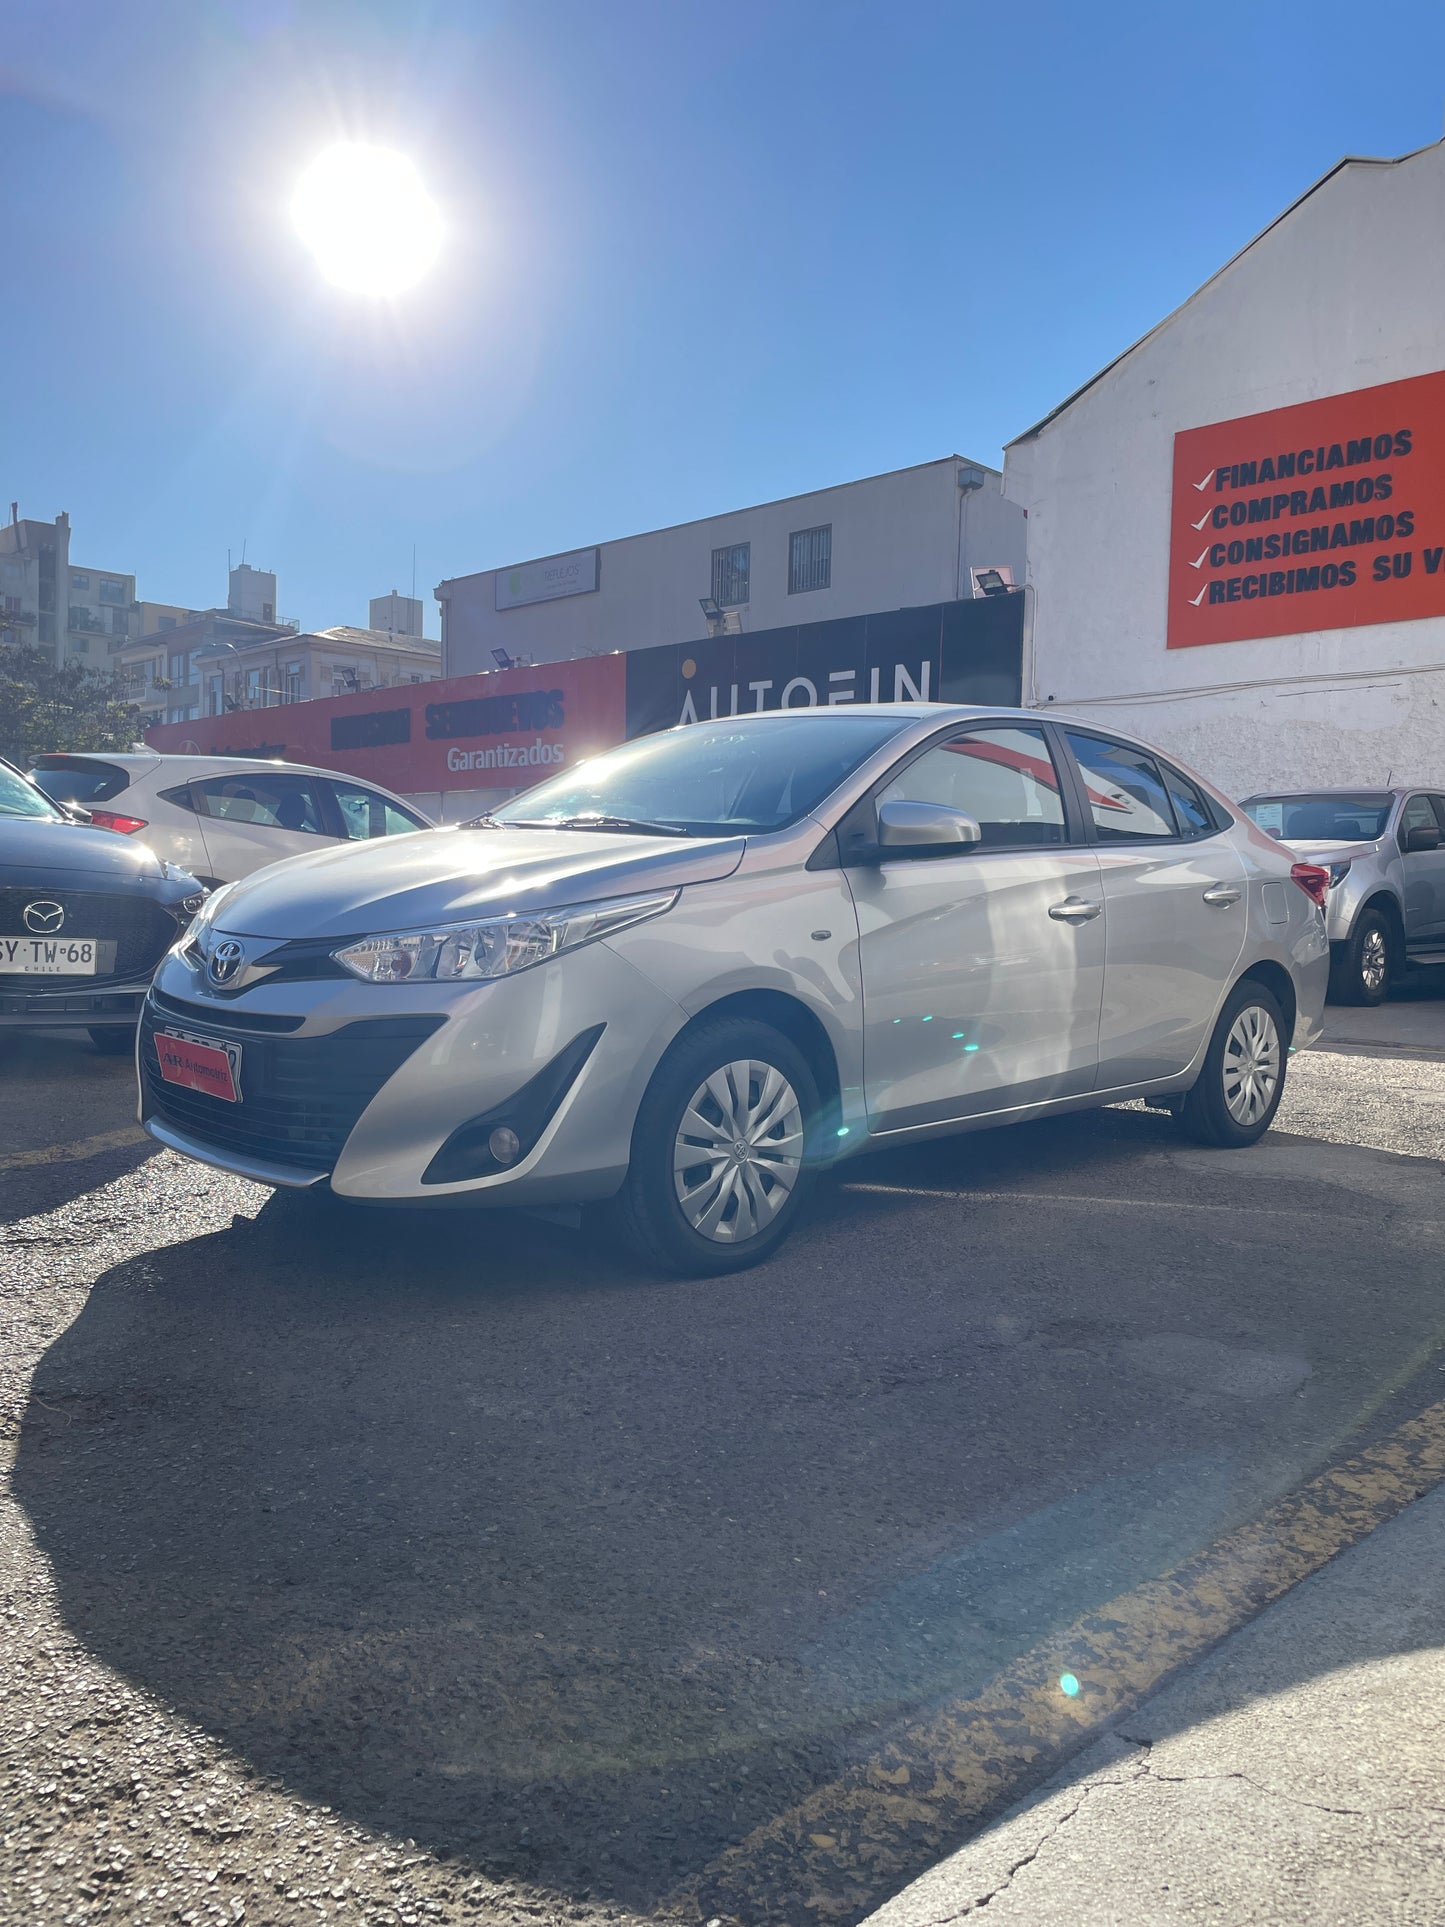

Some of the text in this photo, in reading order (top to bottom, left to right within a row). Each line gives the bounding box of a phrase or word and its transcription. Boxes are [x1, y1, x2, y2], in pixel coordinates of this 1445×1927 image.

[1215, 429, 1413, 492] FINANCIAMOS
[1212, 473, 1393, 530] COMPRAMOS
[1209, 511, 1415, 568] CONSIGNAMOS
[1208, 547, 1445, 605] RECIBIMOS SU V
[679, 661, 931, 726] AUTOFIN
[447, 738, 565, 772] Garantizados
[24, 965, 61, 973] CHILE
